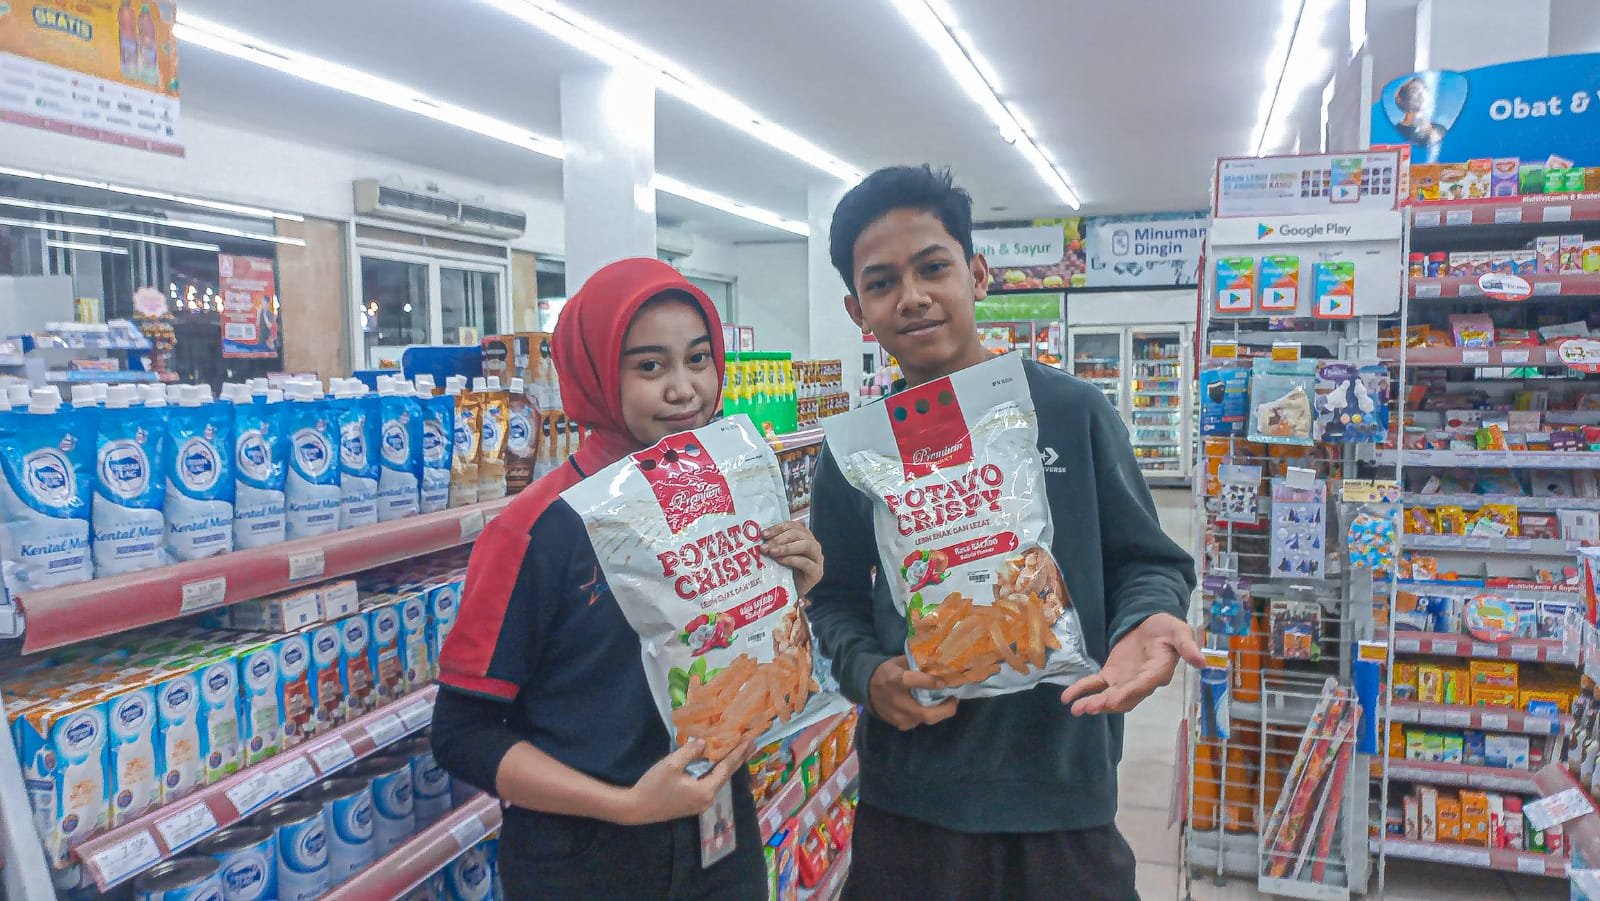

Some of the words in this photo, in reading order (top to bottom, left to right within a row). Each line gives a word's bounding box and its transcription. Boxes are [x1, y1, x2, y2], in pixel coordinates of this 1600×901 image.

[1489, 96, 1562, 120] Obat
[1570, 91, 1591, 114] &
[1135, 227, 1207, 240] Minuman
[1279, 223, 1324, 238] Google
[1326, 222, 1352, 236] Play
[999, 243, 1009, 255] &
[1014, 242, 1051, 256] Sayur
[1134, 242, 1182, 257] Dingin
[913, 441, 963, 465] Premium
[885, 464, 1004, 513] POTATO
[898, 489, 1003, 537] CRISPY
[94, 527, 135, 542] Kental
[171, 518, 208, 533] Kental
[914, 533, 932, 546] LEBIH
[933, 529, 951, 542] ENAK
[953, 525, 969, 535] DAN
[970, 518, 991, 531] LEZAT
[21, 542, 67, 556] Kental
[656, 519, 763, 578] POTATO
[674, 544, 766, 600] CRISPY
